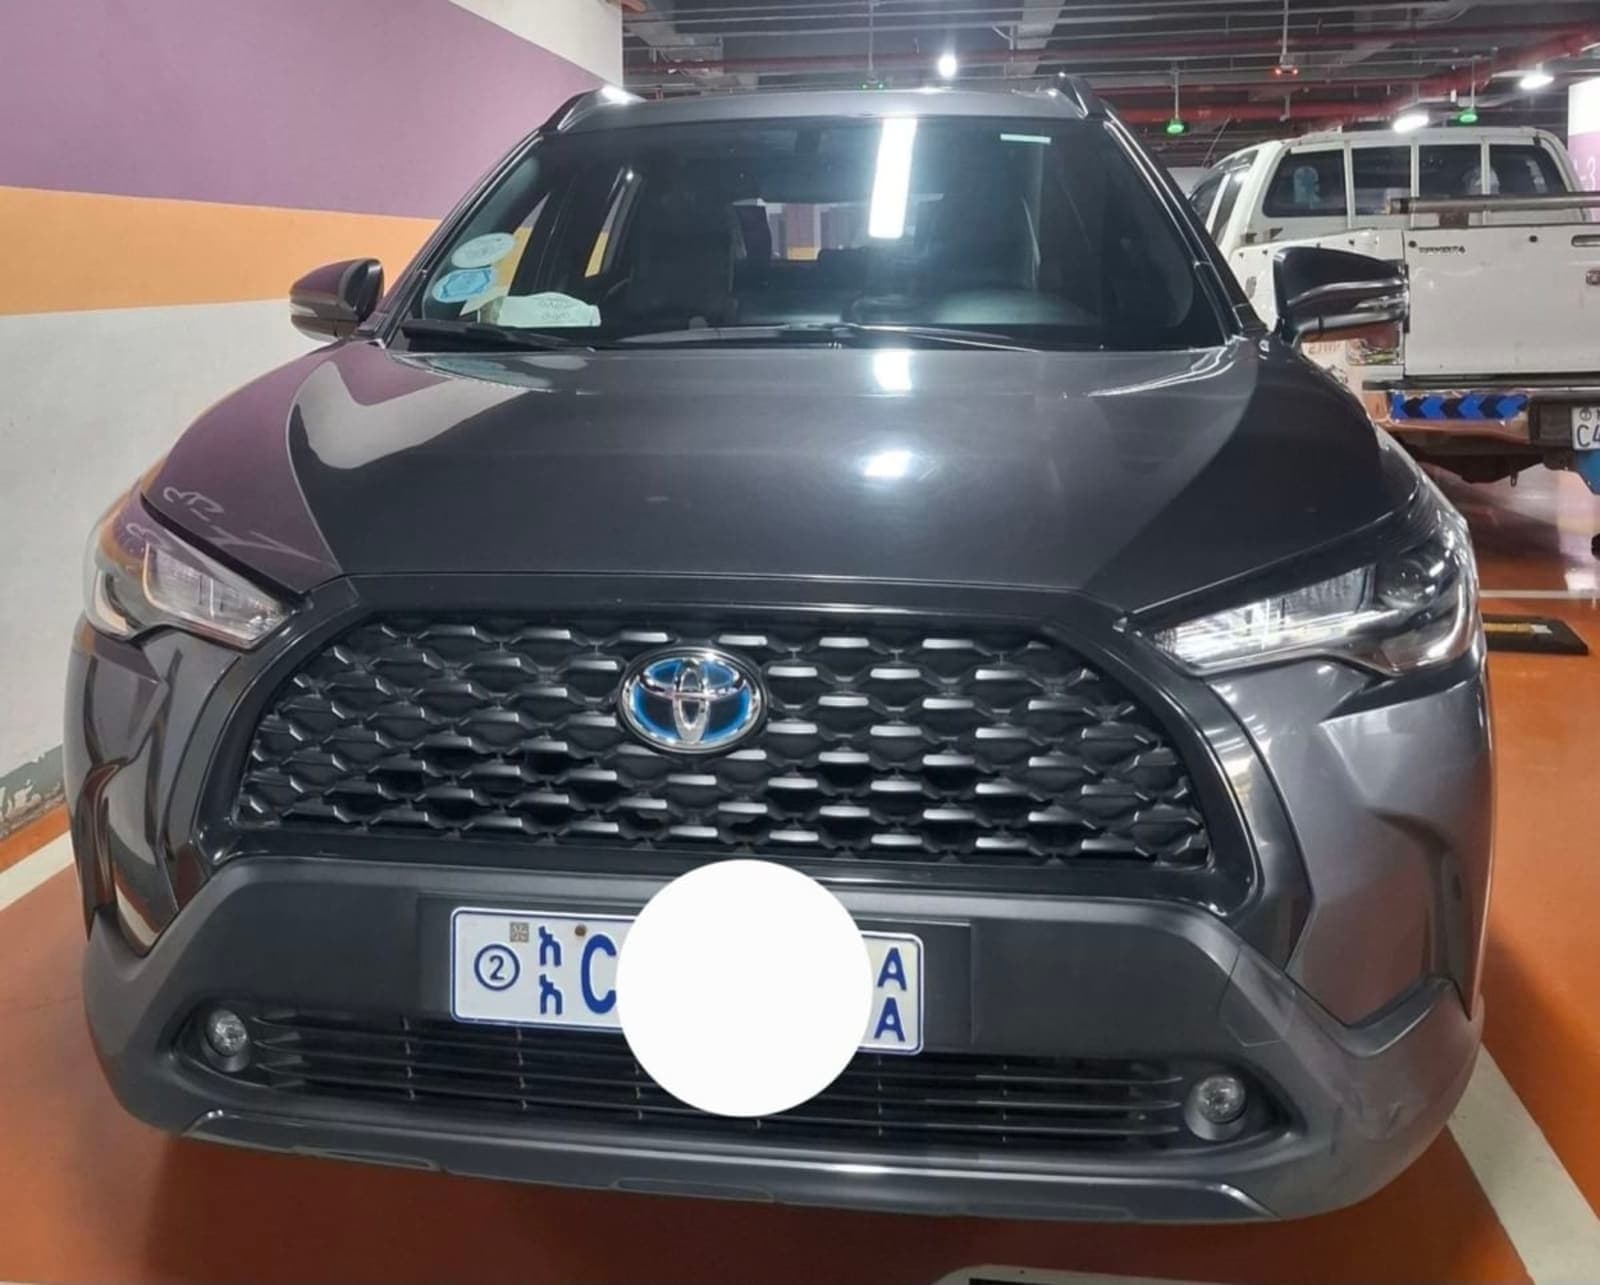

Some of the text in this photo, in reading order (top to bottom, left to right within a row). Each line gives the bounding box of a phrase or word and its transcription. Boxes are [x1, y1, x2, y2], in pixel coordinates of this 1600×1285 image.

[581, 934, 617, 1015] C
[877, 947, 907, 991] A
[873, 997, 905, 1042] A
